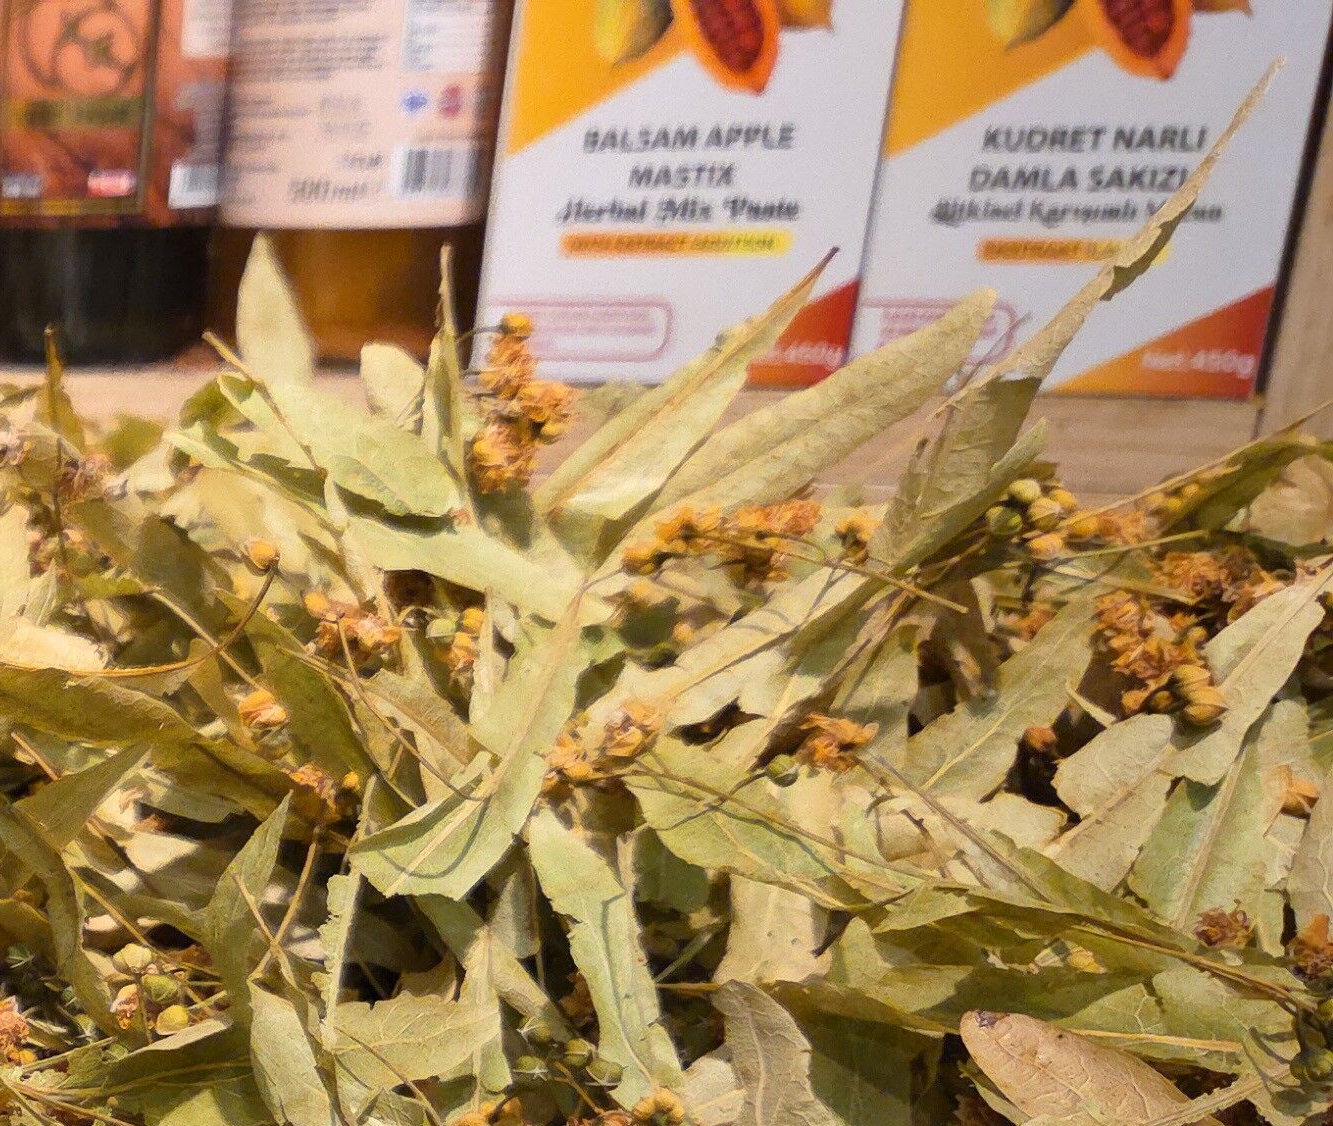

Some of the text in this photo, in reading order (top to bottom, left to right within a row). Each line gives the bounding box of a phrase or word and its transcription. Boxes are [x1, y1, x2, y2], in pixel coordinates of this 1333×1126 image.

[584, 123, 796, 151] BALSAM APPLE
[982, 126, 1207, 151] KUDRET NARLI
[969, 166, 1079, 192] DAMLA
